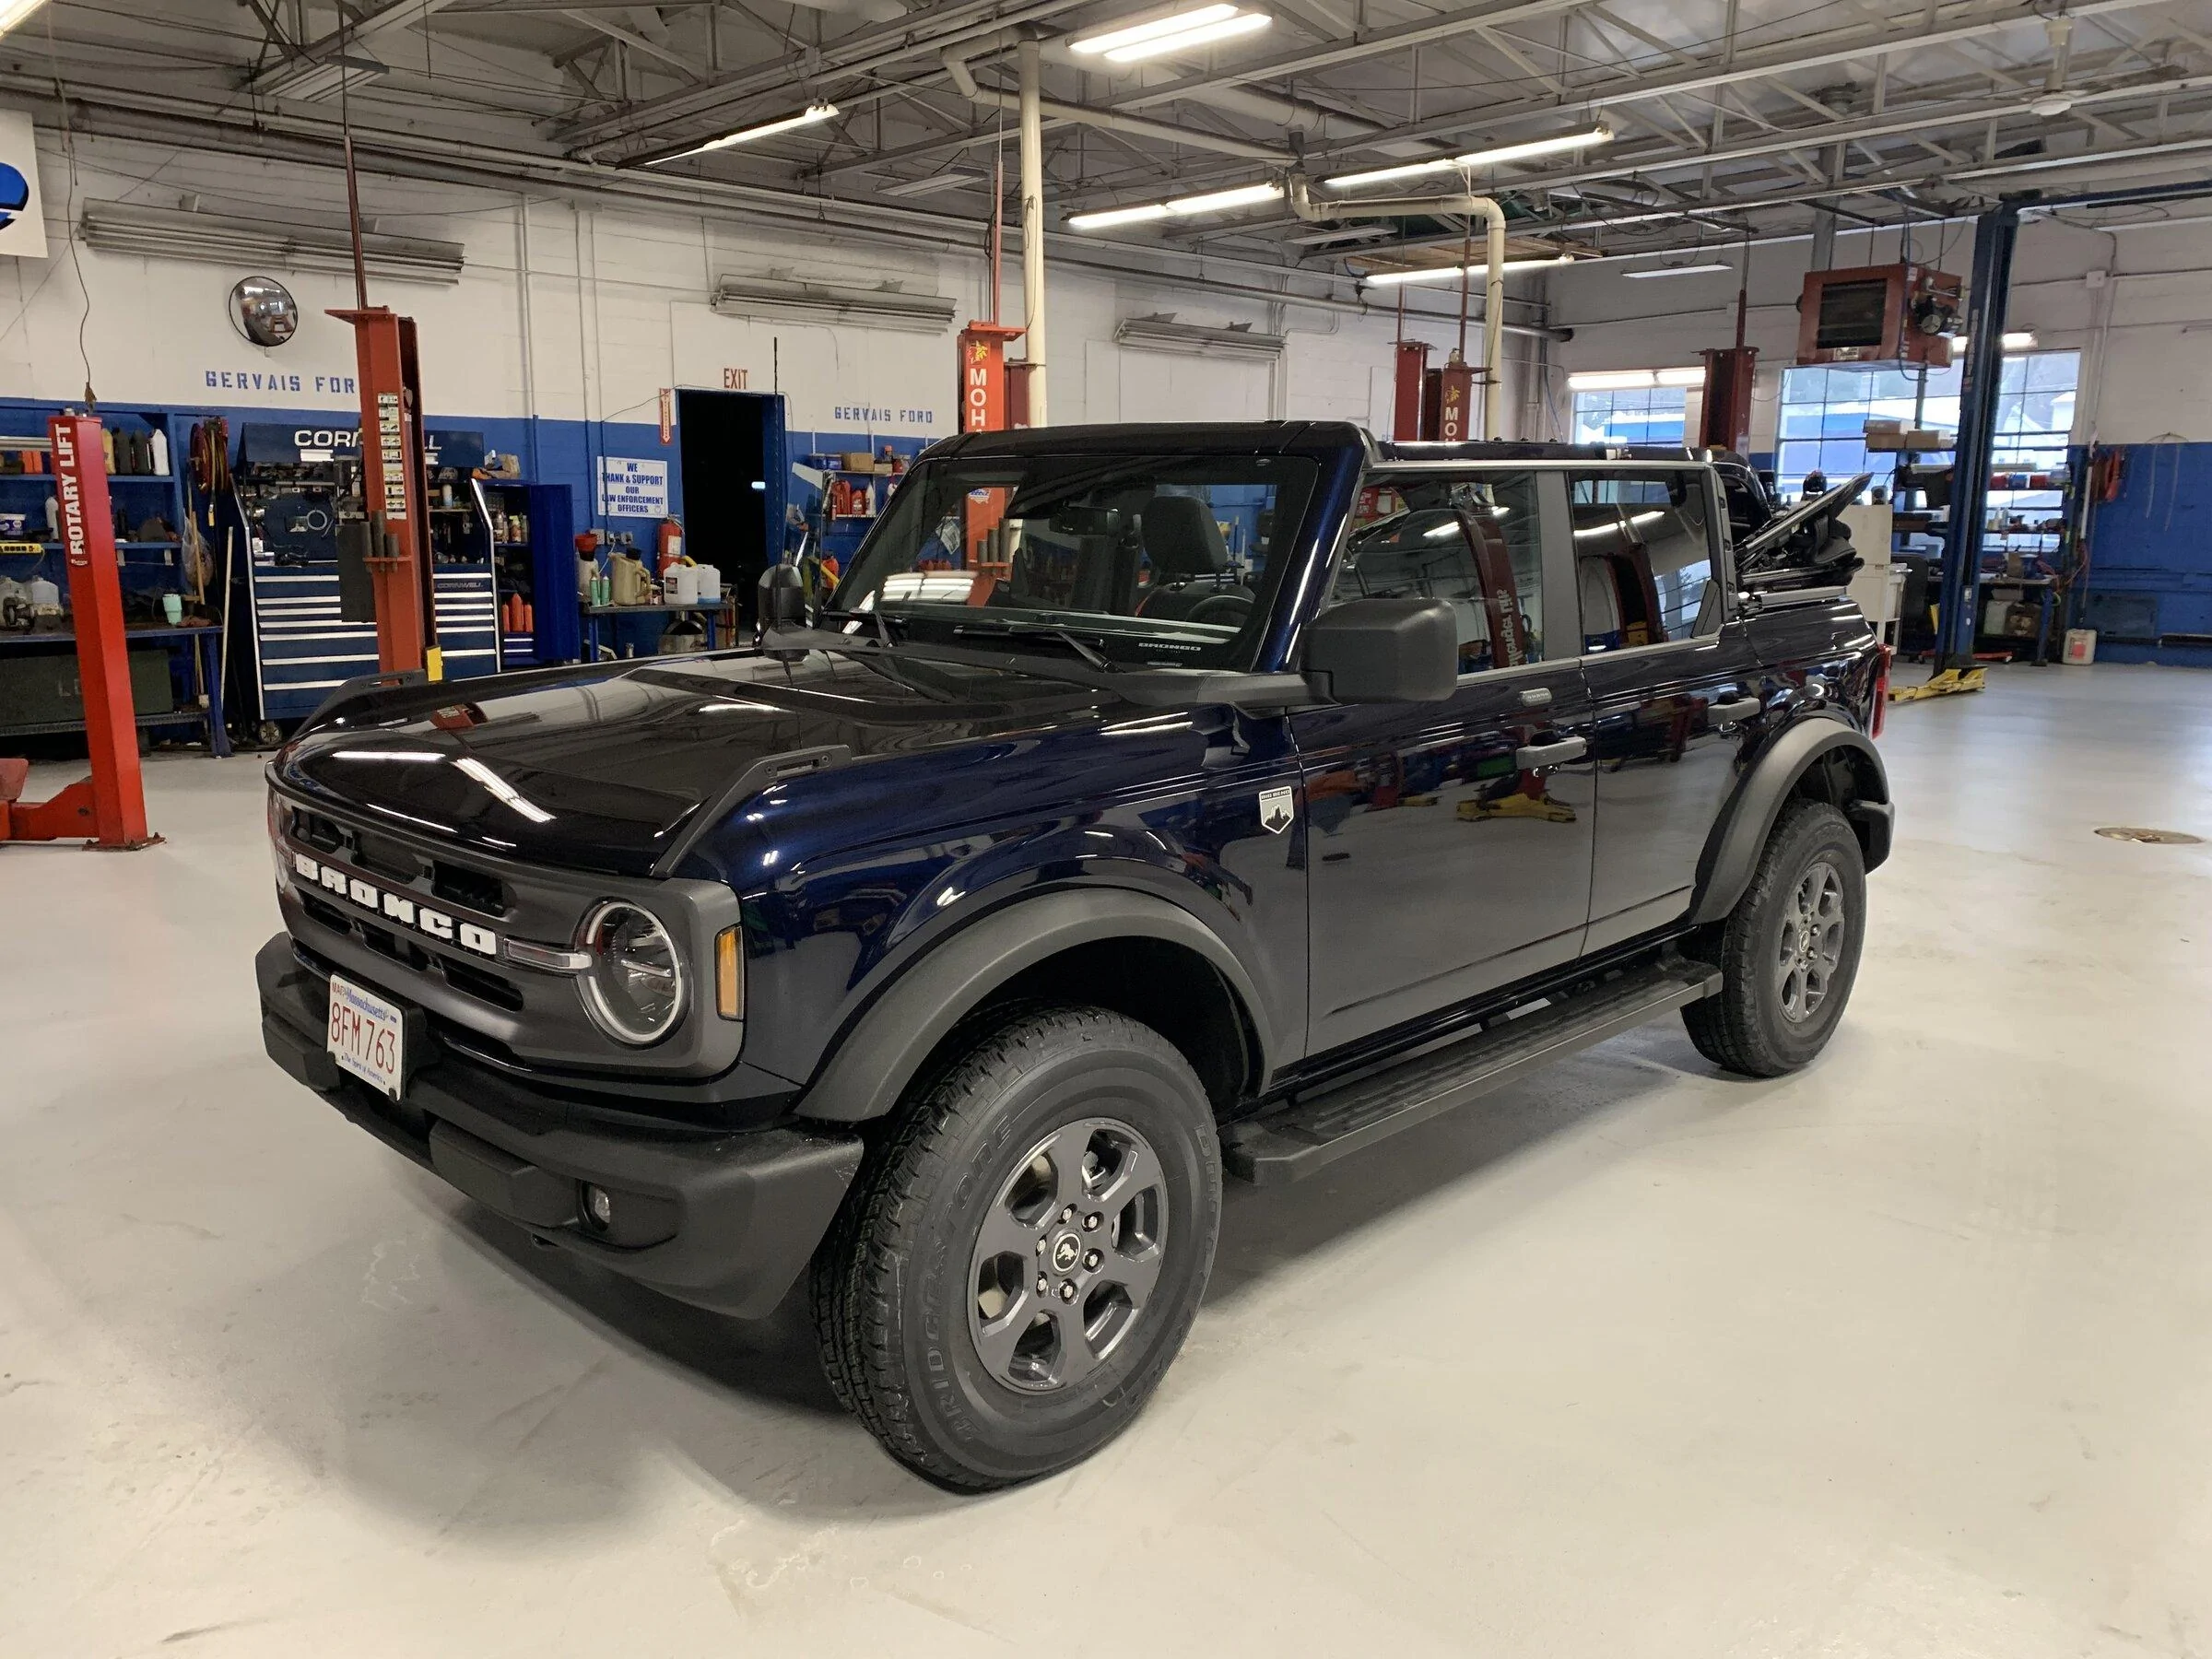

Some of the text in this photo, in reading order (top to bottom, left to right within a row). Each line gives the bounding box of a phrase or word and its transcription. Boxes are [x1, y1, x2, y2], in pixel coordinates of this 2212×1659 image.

[206, 371, 355, 394] GERVAIS FOR
[724, 368, 747, 389] EXIT
[970, 368, 987, 432] MOH
[834, 406, 933, 423] GERVAIS FORD
[1444, 406, 1458, 441] MO
[54, 424, 75, 467] LIFT
[627, 463, 638, 472] WE
[626, 475, 631, 484] &
[631, 475, 664, 485] SUPPORT
[626, 486, 640, 494] OUR
[618, 495, 664, 505] ENFORCEMENT
[618, 504, 649, 512] OFFICERS
[61, 473, 85, 556] ROTARY
[296, 853, 497, 956] BRONCO
[346, 986, 387, 1021] Massachusetts
[331, 1002, 395, 1074] 8FM 763
